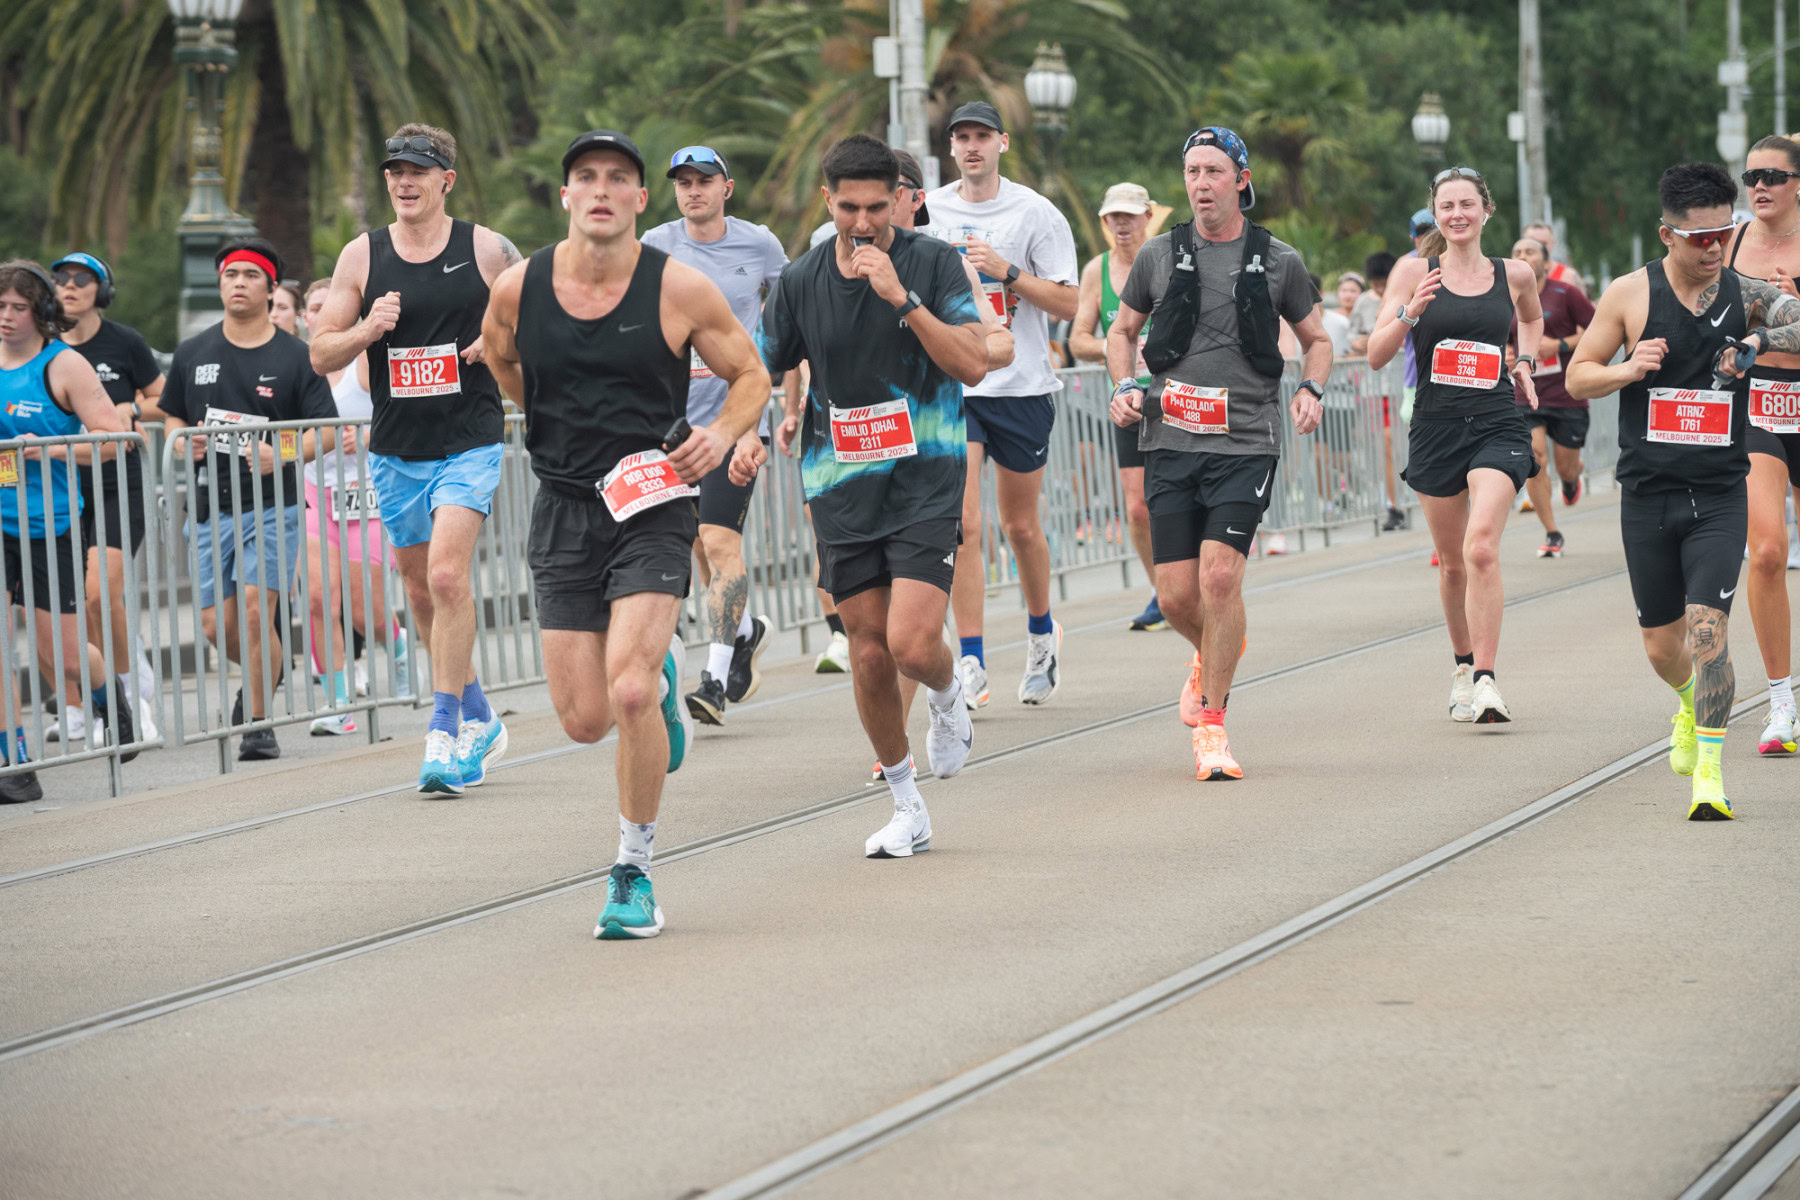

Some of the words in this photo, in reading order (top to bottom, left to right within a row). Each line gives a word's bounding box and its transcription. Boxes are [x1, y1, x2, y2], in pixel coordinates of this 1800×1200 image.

[1457, 353, 1478, 365] SOPH
[195, 363, 221, 375] DEEP
[400, 359, 446, 386] 9182
[1456, 365, 1476, 377] 3746
[194, 373, 219, 385] HEAT
[1436, 375, 1476, 386] MELBOURNE
[1476, 379, 1493, 387] 2025
[396, 387, 434, 396] MELBOURNE
[436, 384, 454, 393] 2025
[1185, 398, 1215, 412] COLADA
[1675, 404, 1706, 418] ATRNZ
[1761, 392, 1800, 417] 680
[1182, 410, 1201, 423] 1488
[1755, 417, 1796, 425] MELBOURNE
[840, 423, 868, 438] EMILIO
[870, 418, 899, 435] JOHAL
[1169, 416, 1201, 432] MELBOURNE
[1202, 425, 1221, 433] 2025
[1680, 418, 1701, 431] 1761
[859, 435, 882, 450] 2311
[1655, 432, 1701, 442] MELBOURNE
[1703, 435, 1723, 443] 2025
[842, 450, 886, 461] MELBOURNE
[887, 446, 908, 457] 2025
[623, 469, 645, 487] ROB
[637, 478, 666, 495] 3333
[622, 489, 673, 515] MELBOURNE
[672, 485, 693, 495] 2025
